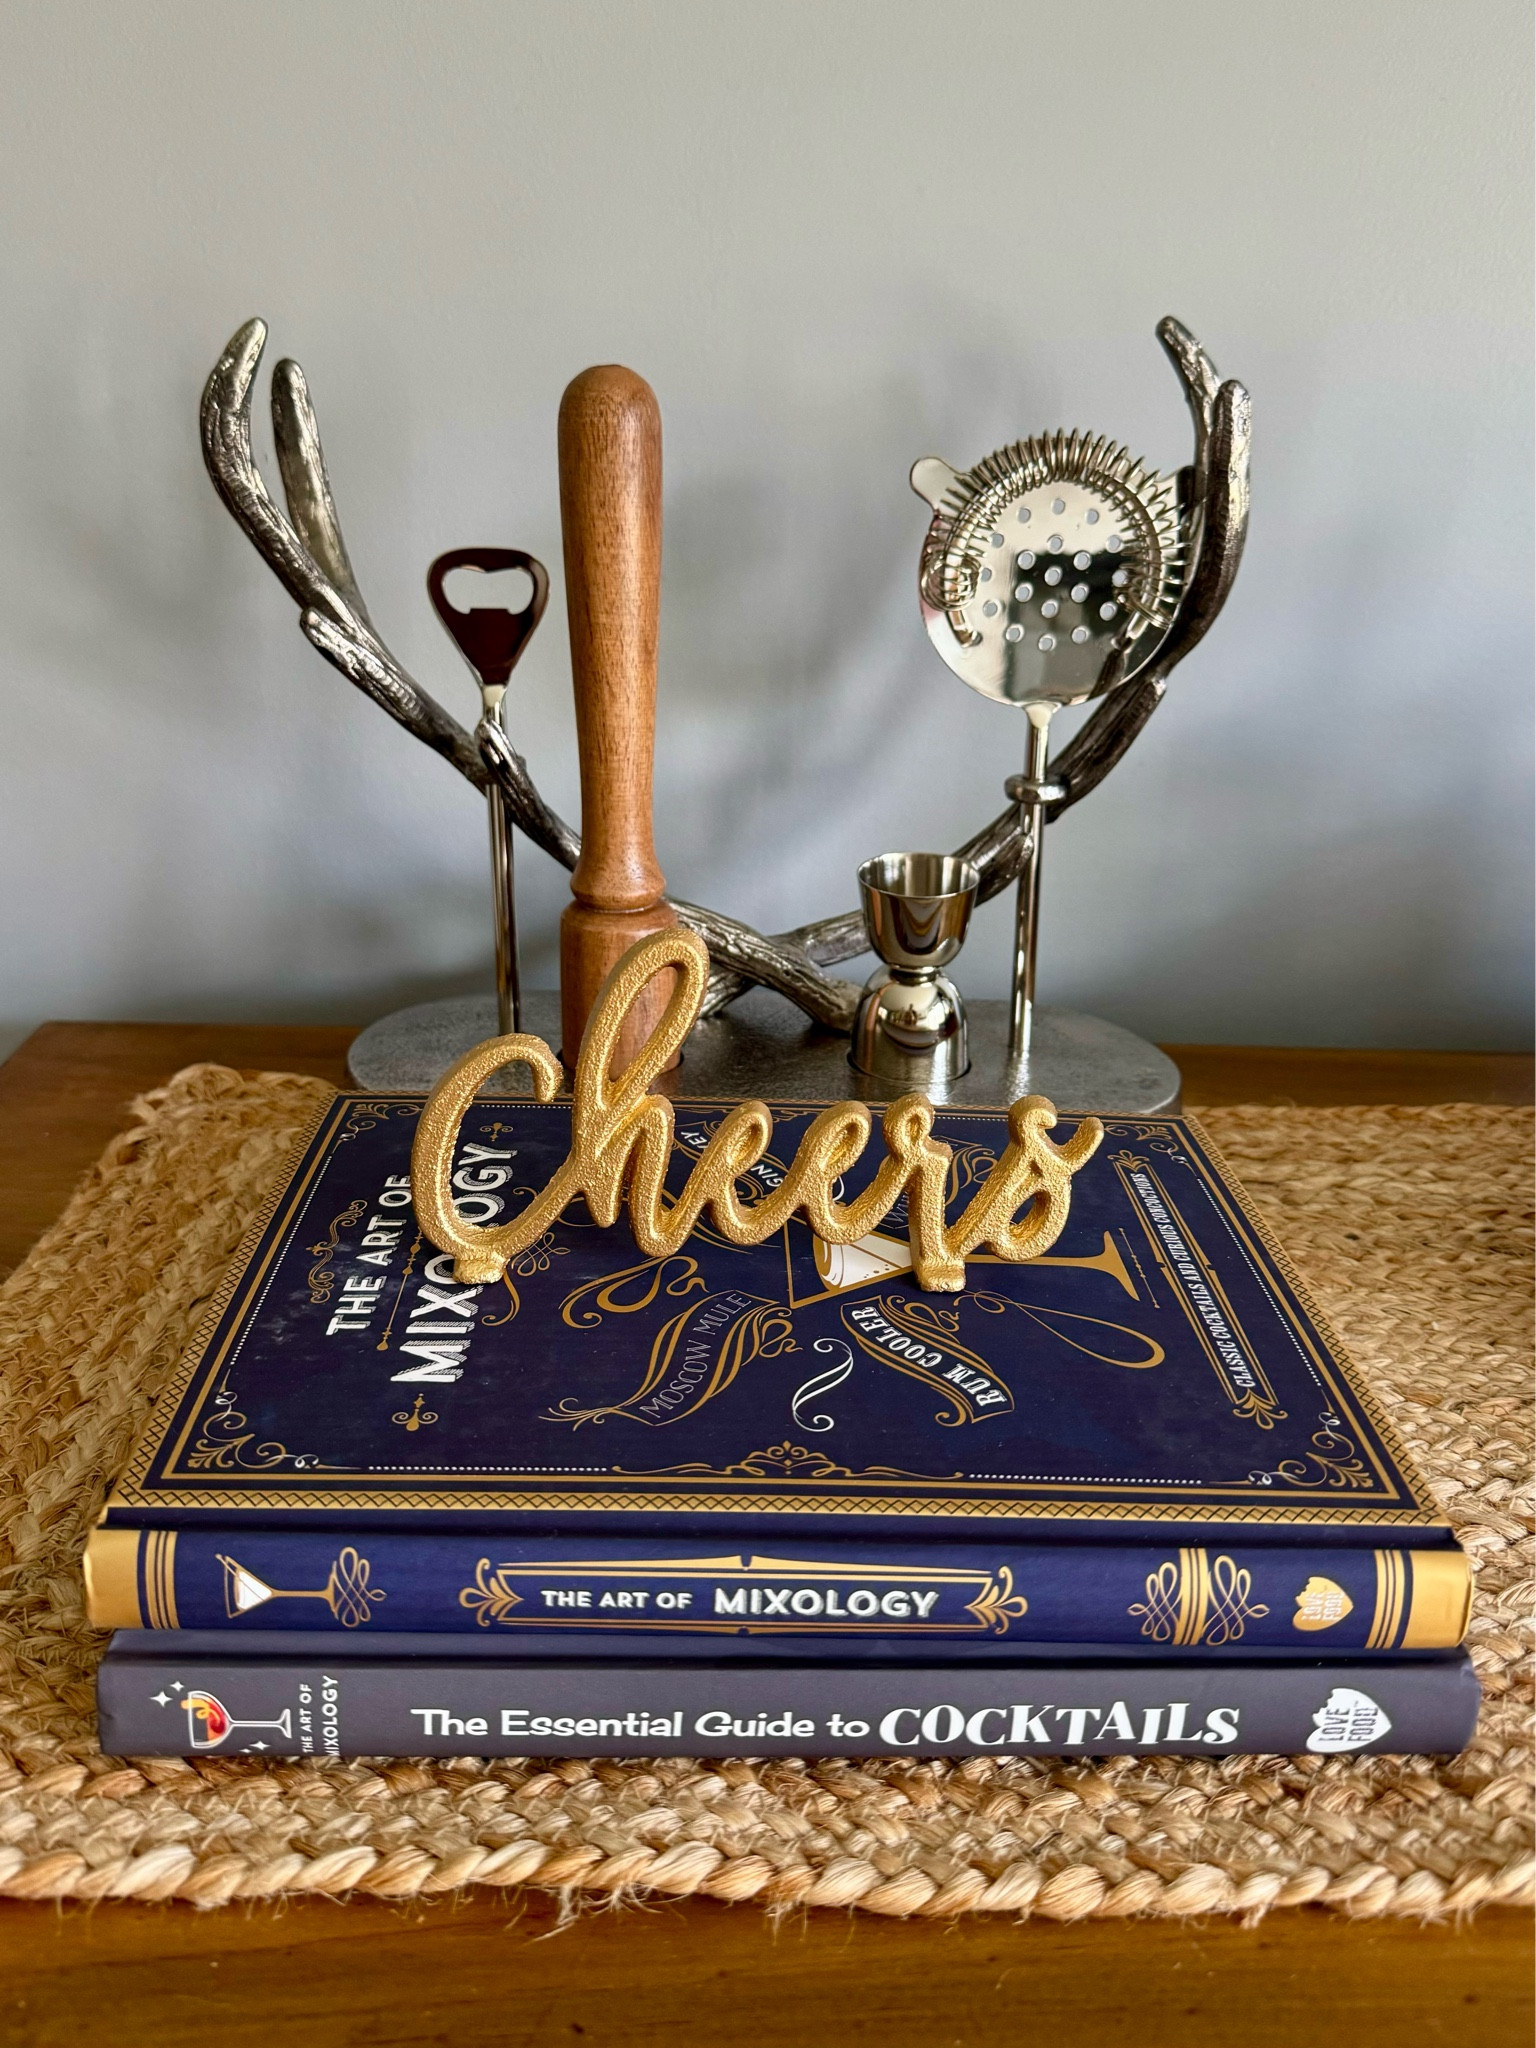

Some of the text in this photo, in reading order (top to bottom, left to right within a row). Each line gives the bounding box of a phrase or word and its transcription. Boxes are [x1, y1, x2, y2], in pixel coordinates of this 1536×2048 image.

[411, 931, 1106, 1291] Cheers
[326, 1173, 413, 1335] THE ART OF
[1130, 1173, 1257, 1388] CLASSIC COCKTAILS AND CURIOUS CONCOCTIONS
[639, 1293, 752, 1418] MOSCOW MULE
[851, 1306, 1008, 1407] RUM COOLER
[541, 1587, 939, 1618] THE ART OF MIXOLOGY
[299, 1684, 314, 1753] THE ART OF
[410, 1701, 1240, 1746] The Essential Guide to COCKTAILS
[1318, 1708, 1350, 1742] LOVE
[1347, 1707, 1379, 1742] FOOD
